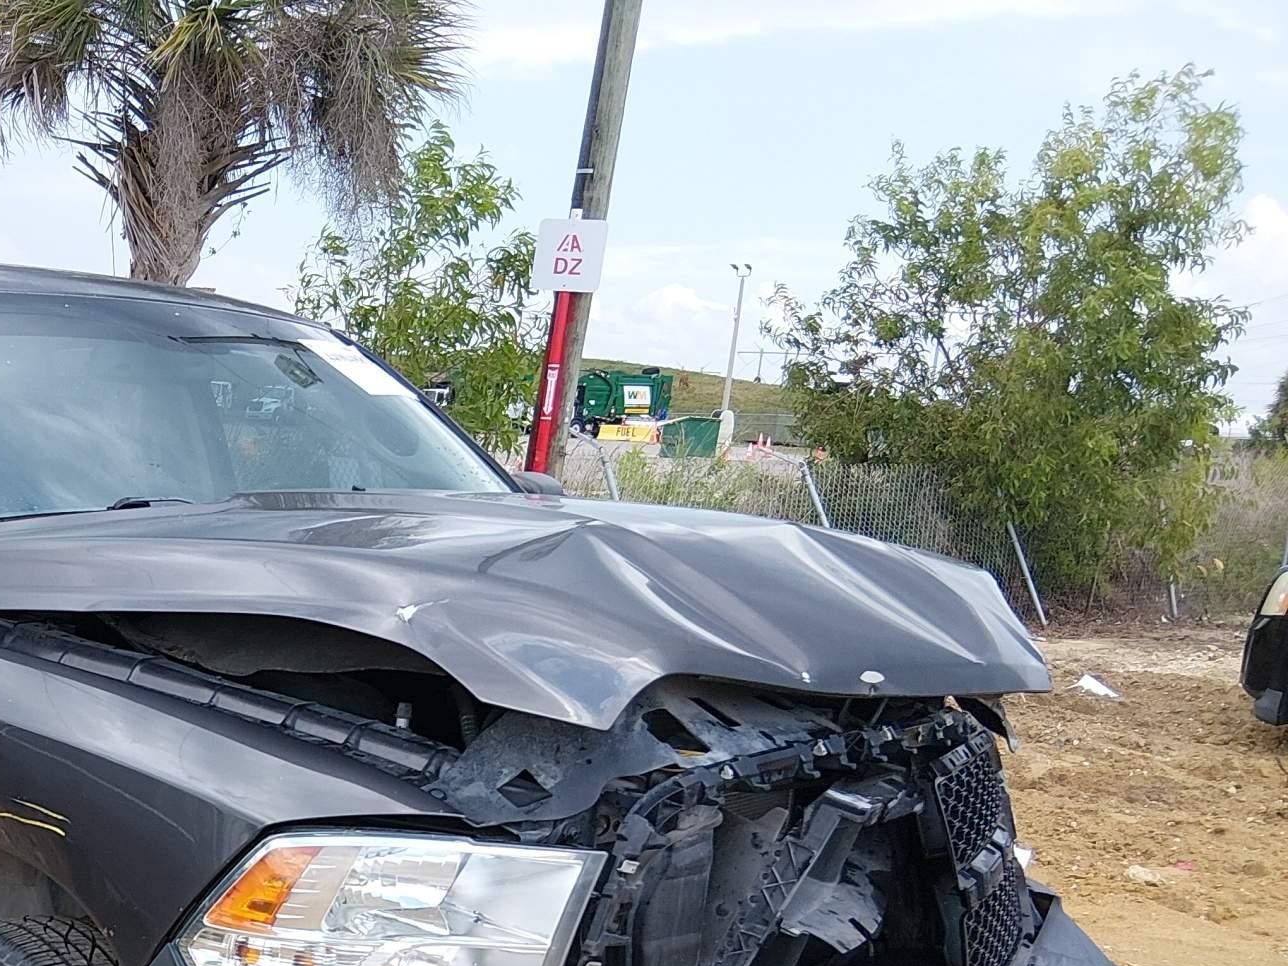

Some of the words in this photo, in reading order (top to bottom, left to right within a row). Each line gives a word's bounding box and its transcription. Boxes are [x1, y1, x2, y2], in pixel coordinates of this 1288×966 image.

[553, 257, 583, 276] DZ
[627, 390, 647, 400] WM
[616, 426, 637, 438] FUEL
